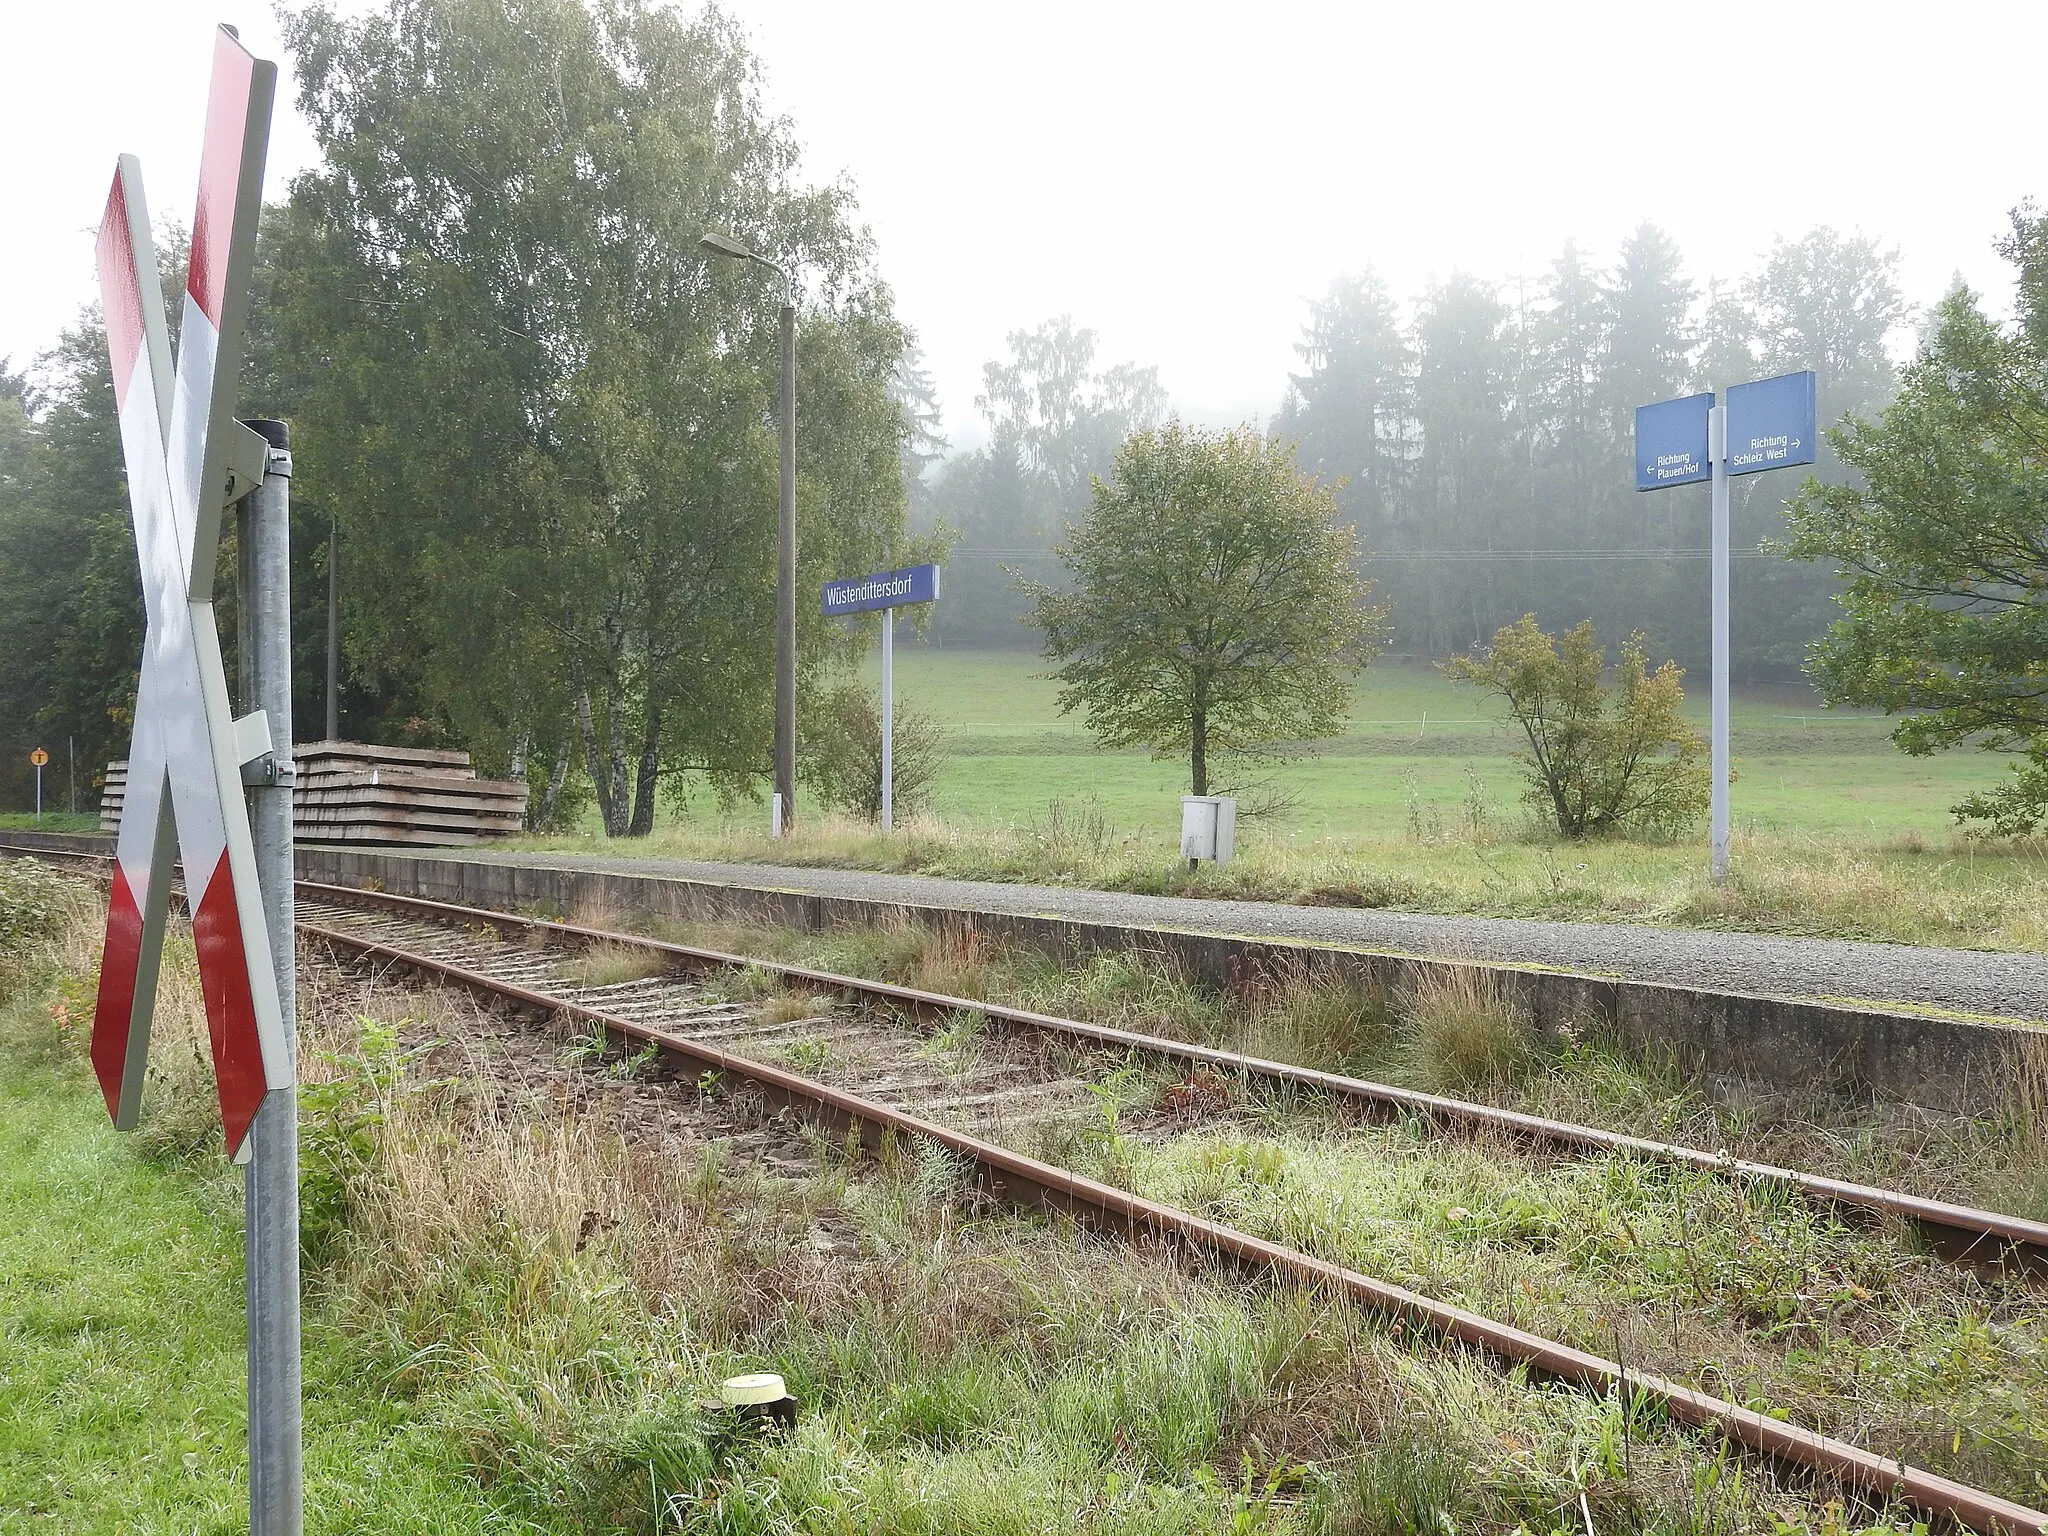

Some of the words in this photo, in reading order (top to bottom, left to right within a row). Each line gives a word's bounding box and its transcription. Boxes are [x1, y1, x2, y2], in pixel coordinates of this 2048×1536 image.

[1751, 435, 1787, 449] Richtung
[1657, 453, 1690, 466] Richtung
[1733, 452, 1763, 466] Schleiz
[1766, 447, 1788, 460] West
[1657, 462, 1699, 479] Plauen/Hof
[827, 574, 912, 605] Wüstendittersdorf
